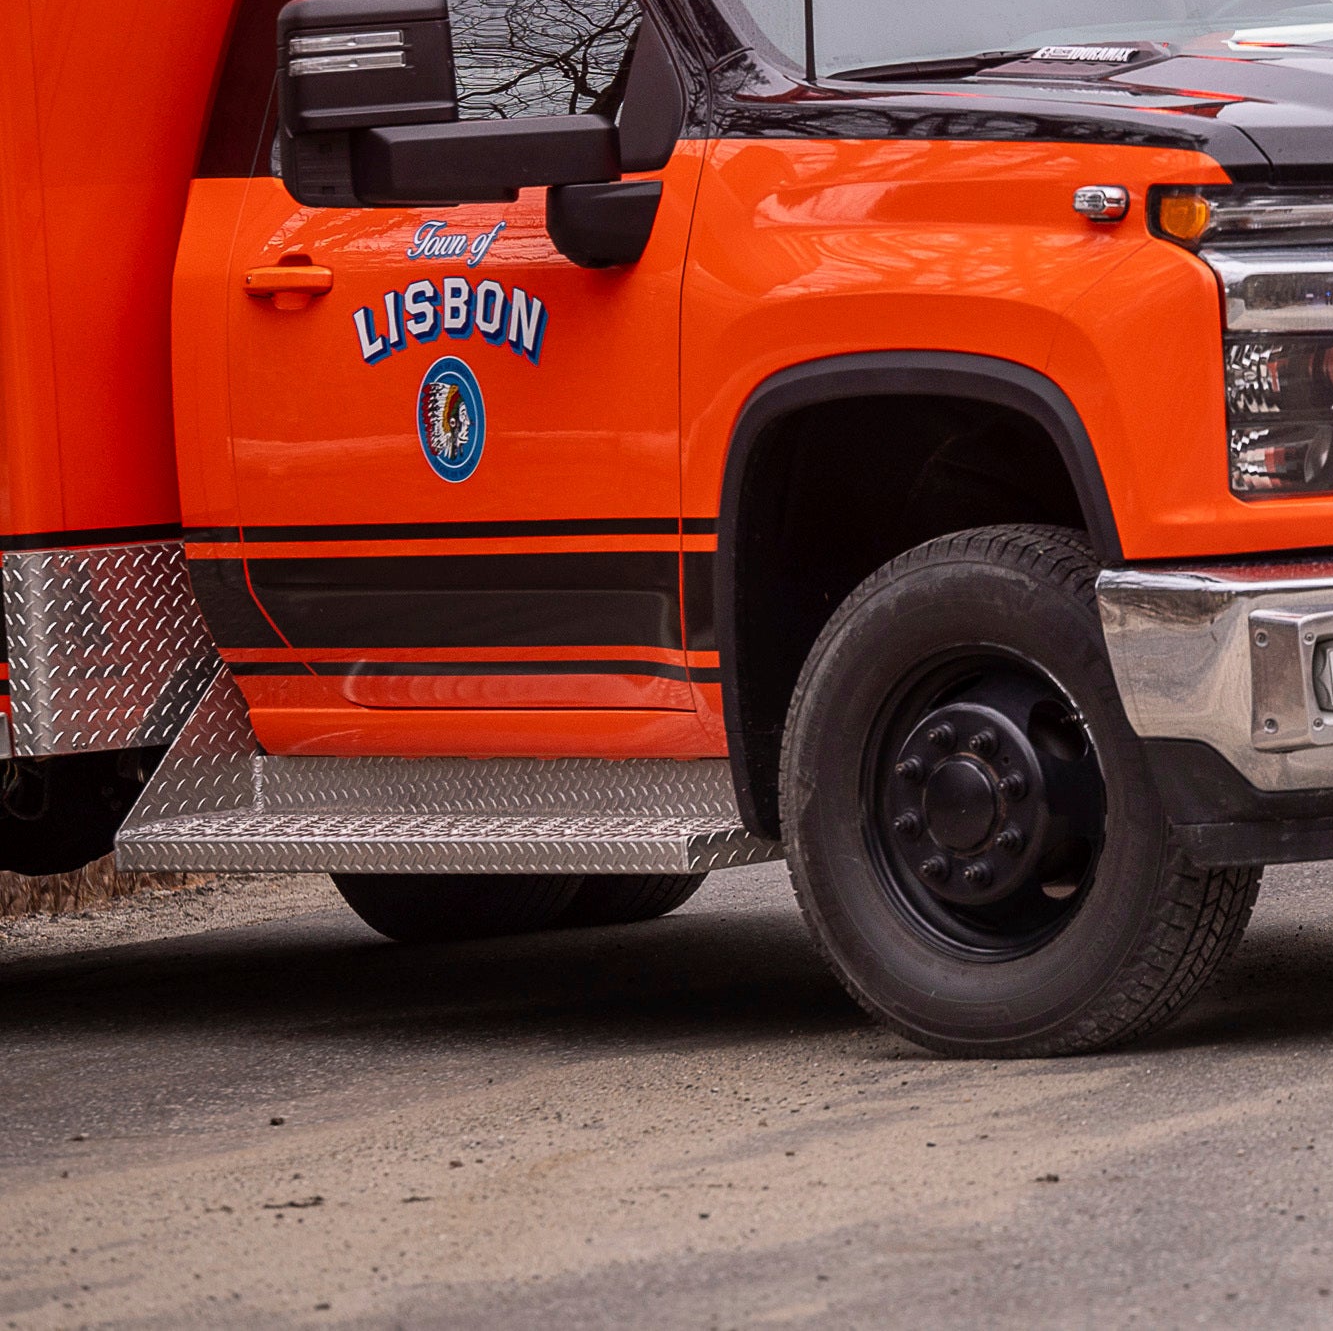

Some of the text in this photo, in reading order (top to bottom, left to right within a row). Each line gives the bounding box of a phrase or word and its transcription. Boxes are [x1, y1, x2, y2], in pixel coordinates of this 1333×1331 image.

[407, 220, 507, 268] Town of
[353, 276, 549, 367] LISBON
